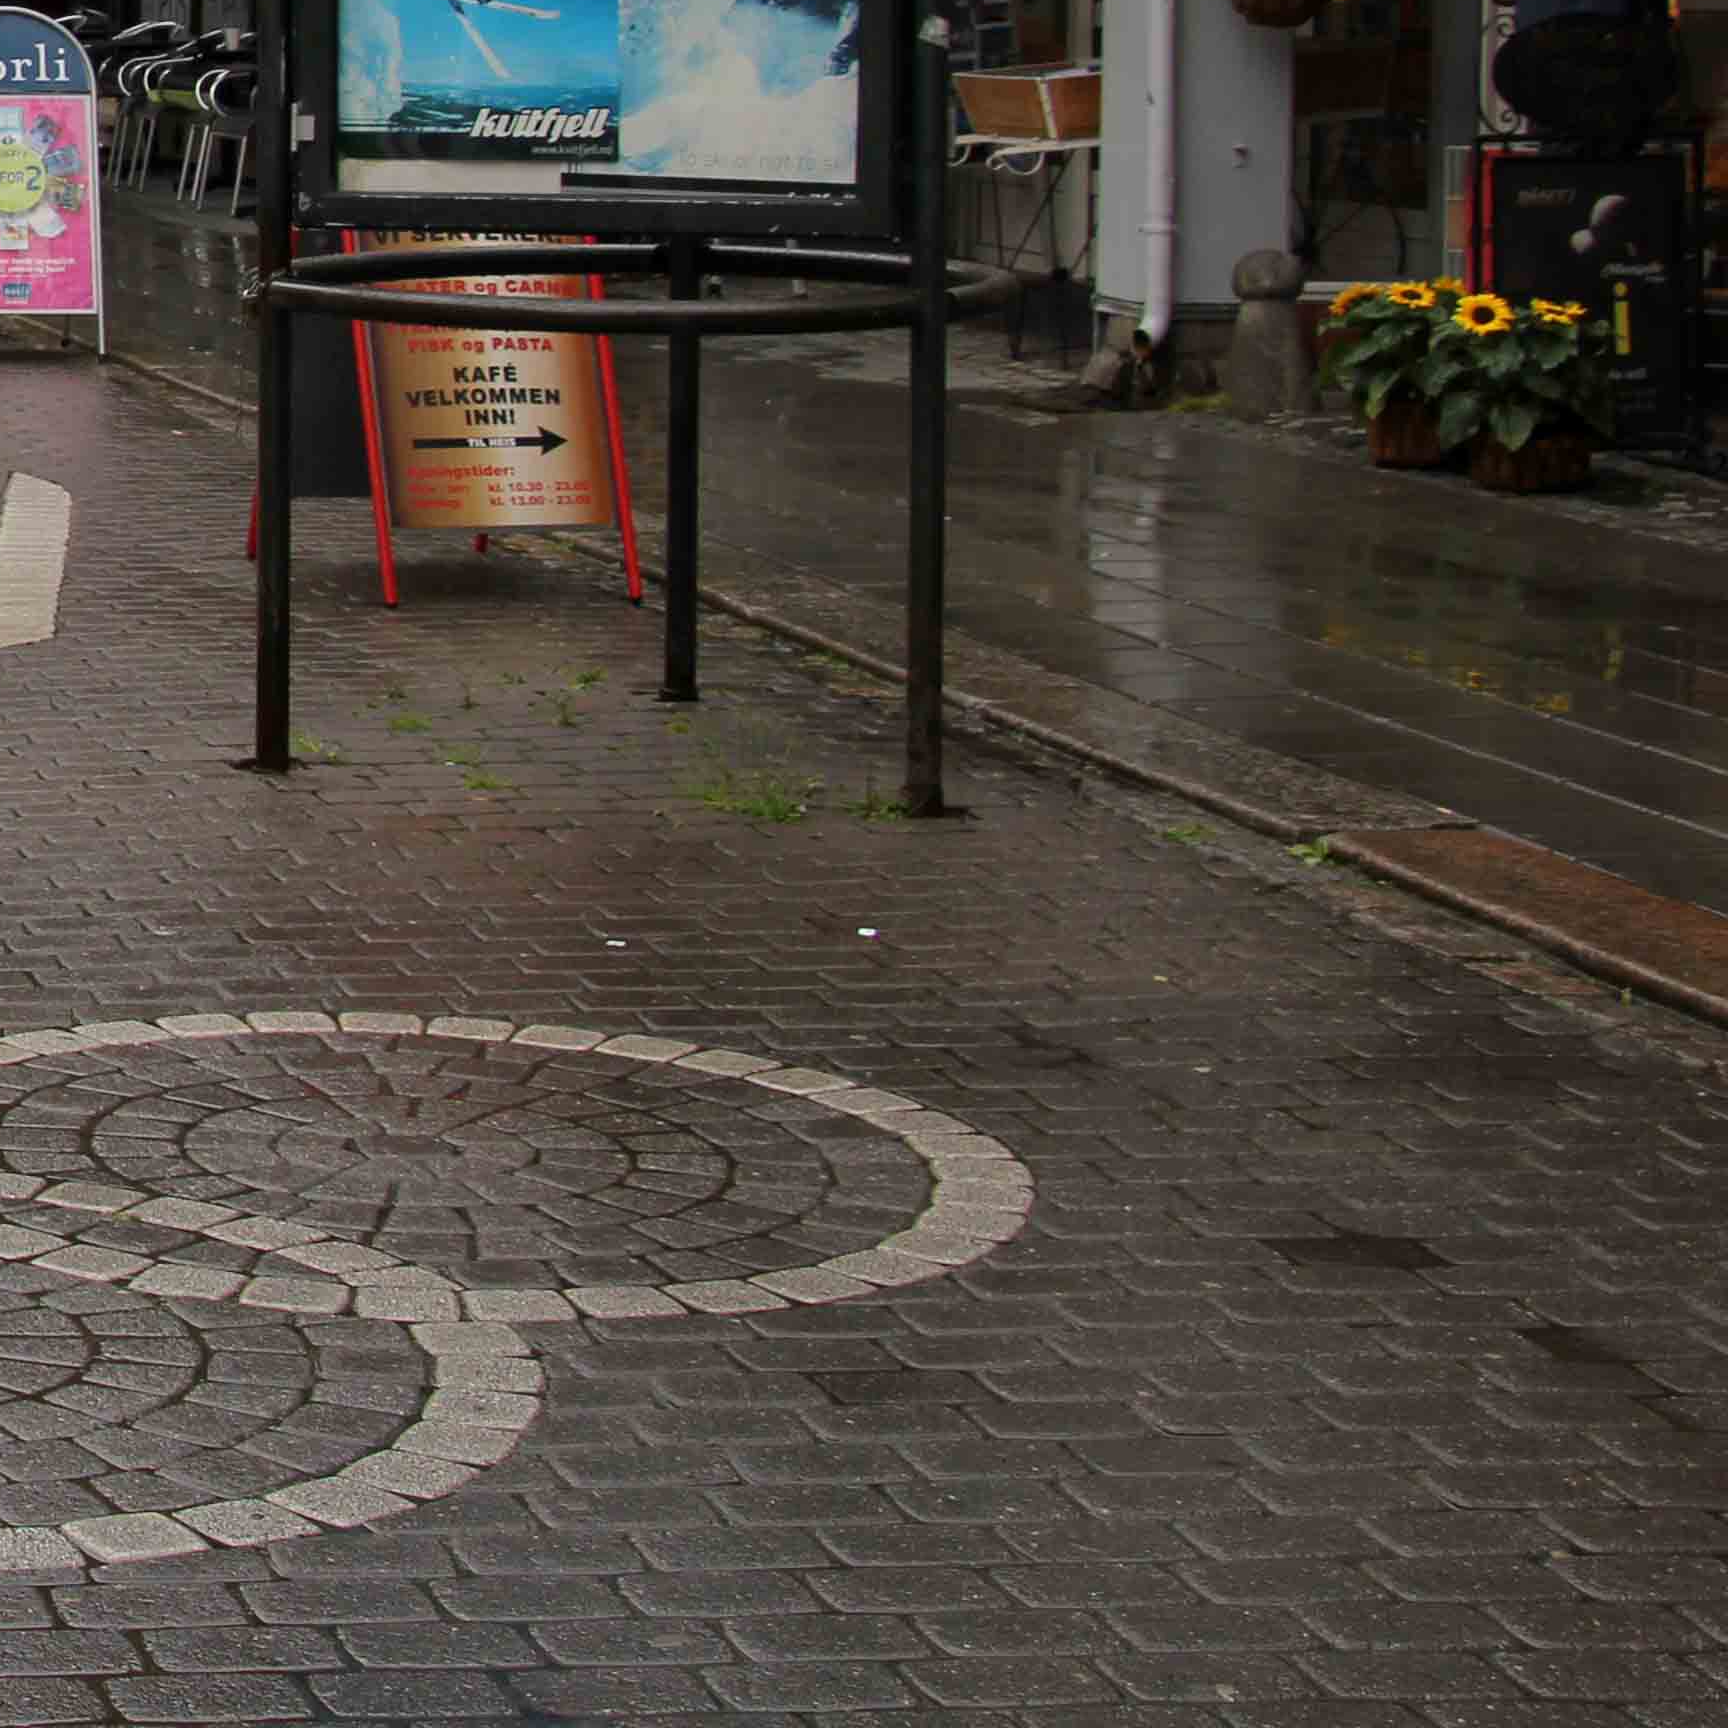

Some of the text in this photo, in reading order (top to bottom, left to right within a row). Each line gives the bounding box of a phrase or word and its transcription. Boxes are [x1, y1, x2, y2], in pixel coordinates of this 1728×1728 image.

[468, 105, 613, 144] kvitfjell
[25, 165, 43, 192] 2
[474, 281, 498, 296] og
[463, 340, 486, 355] og
[492, 337, 555, 352] PASTA
[452, 363, 519, 384] KAFÉ
[405, 388, 561, 408] VELKOMMEN
[464, 408, 516, 426] INN!
